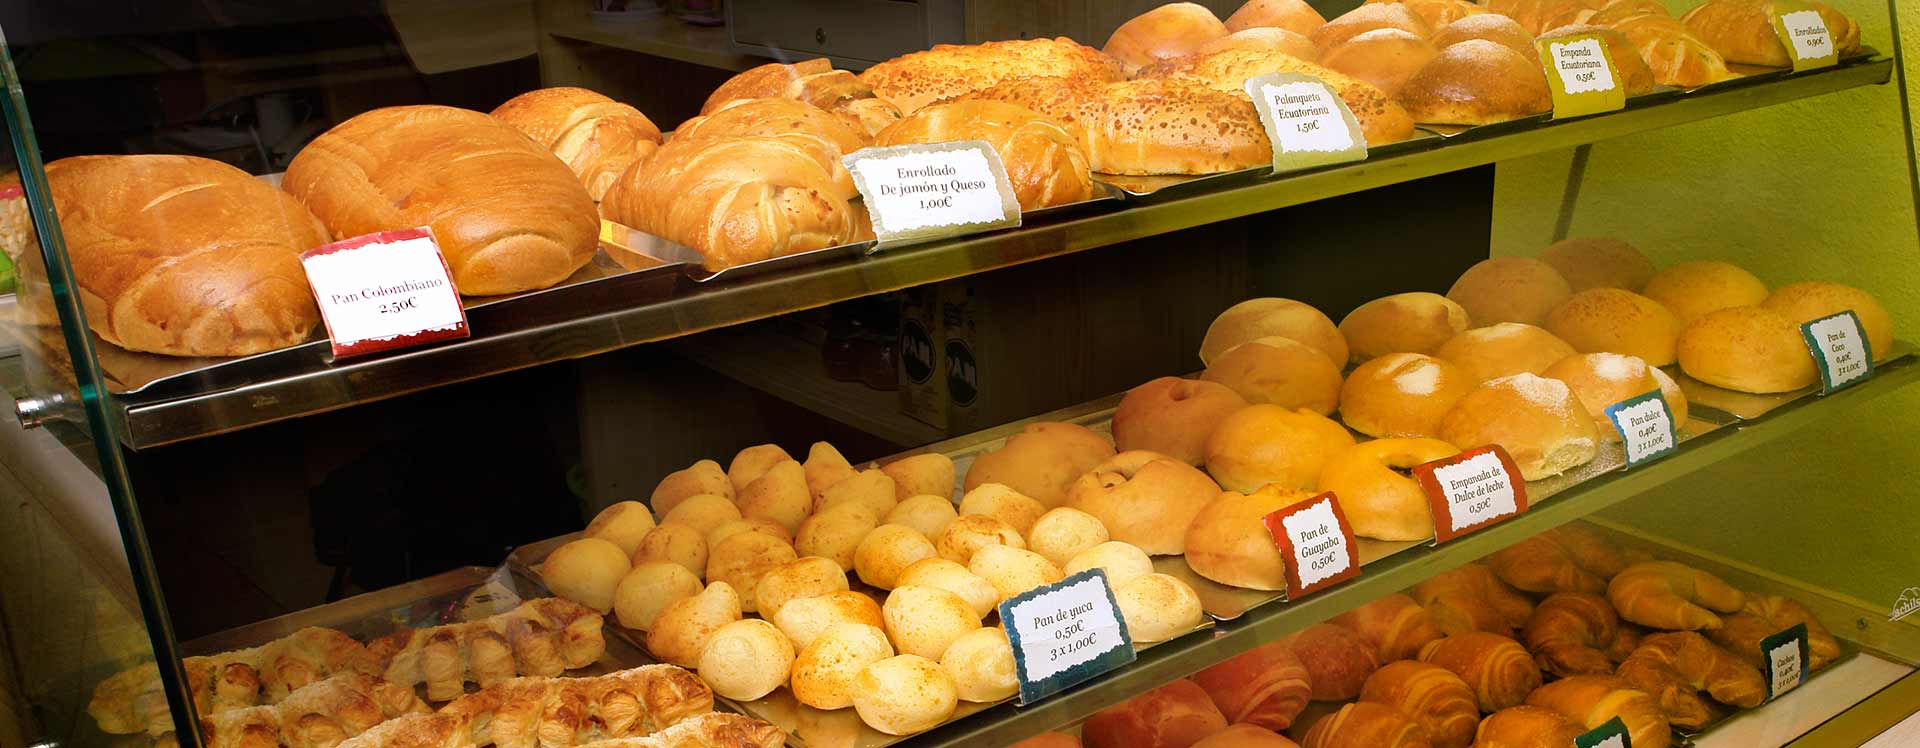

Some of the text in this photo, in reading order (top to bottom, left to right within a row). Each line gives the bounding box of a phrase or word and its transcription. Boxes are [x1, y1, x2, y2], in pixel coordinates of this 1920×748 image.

[1559, 46, 1592, 59] Empanda
[1561, 59, 1601, 70] Ecuatoriana
[1575, 71, 1596, 83] 0,50€
[1274, 93, 1321, 106] Palanqueta
[1278, 105, 1329, 120] Ecuatoriana
[897, 164, 956, 179] Enrollado
[880, 179, 986, 197] De jamón y Queso
[920, 196, 953, 211] 1,00€
[331, 278, 443, 305] Pan Colombiano
[1827, 329, 1846, 342] Pan de
[1831, 343, 1846, 353] Coco
[1630, 410, 1661, 427] Pan dulce
[1638, 423, 1657, 438] 0,40€
[1637, 444, 1642, 454] 3
[1450, 466, 1501, 491] Empanada de
[1454, 480, 1504, 504] Dulce de leche
[1469, 497, 1492, 514] 0,50€
[1300, 524, 1329, 542] Pan de
[1301, 536, 1340, 558] Guayaba
[1311, 551, 1336, 571] 0,50€
[1033, 601, 1094, 630] Pan de yuca
[1055, 619, 1085, 640] 0,50€
[1050, 632, 1097, 662] 3 x 1,00€
